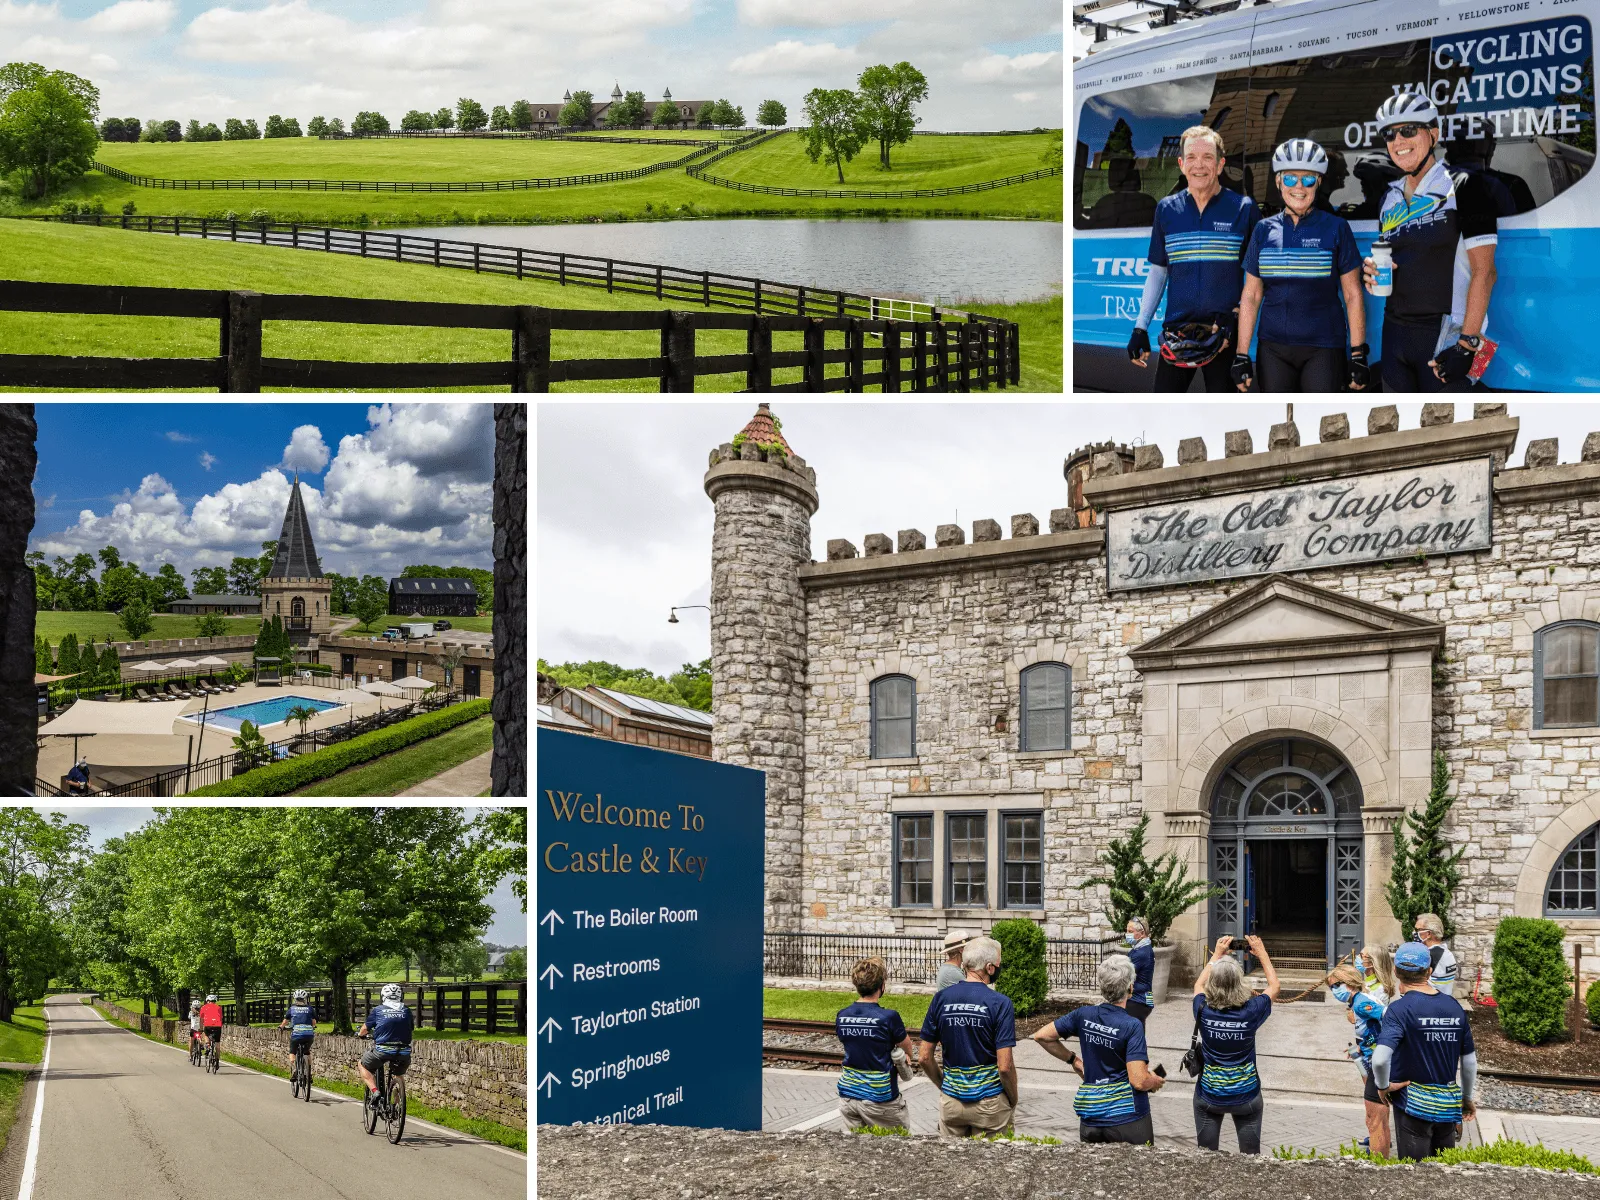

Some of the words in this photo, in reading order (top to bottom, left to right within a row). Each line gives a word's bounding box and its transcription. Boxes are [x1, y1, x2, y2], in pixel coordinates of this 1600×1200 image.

[1111, 75, 1122, 83] NEW
[1123, 71, 1143, 80] MEXICO
[1176, 62, 1191, 71] PALM
[1192, 57, 1218, 68] SPRINGS
[1229, 52, 1250, 60] SANTA
[1252, 45, 1284, 57] BARBARA
[1297, 36, 1331, 49] SOLVANG
[1346, 28, 1379, 40] TUCSON
[1396, 18, 1439, 31] VERMONT
[1458, 2, 1530, 21] YELLOWSTONE
[1434, 24, 1583, 70] CYCLING
[1344, 120, 1378, 148] OF
[1437, 104, 1581, 142] IFETIME
[1092, 257, 1152, 276] TRE
[1133, 509, 1208, 546] The
[1222, 496, 1298, 534] Old
[1309, 476, 1456, 527] Taylor
[1119, 540, 1285, 581] Distillery
[1303, 515, 1478, 559] Company
[544, 789, 671, 830] Welcome
[678, 804, 705, 832] To
[1294, 824, 1308, 834] Key
[544, 841, 633, 873] Castle
[640, 847, 660, 874] &
[667, 847, 709, 882] Key
[572, 910, 606, 929] The
[610, 908, 656, 927] Boiler
[659, 907, 698, 924] Room
[573, 958, 661, 983] Restrooms
[571, 1007, 647, 1036] Taylorton
[651, 996, 700, 1018] Station
[943, 1003, 988, 1014] TREK
[838, 1016, 880, 1026] TREK
[945, 1016, 984, 1029] TRAVEL
[1083, 1019, 1120, 1036] TREK
[1204, 1018, 1249, 1029] TREK
[1417, 1017, 1461, 1026] TREK
[841, 1027, 876, 1038] TRAVEL
[1084, 1032, 1115, 1050] TRAVEL
[1208, 1029, 1246, 1041] TRAVEL
[1423, 1032, 1458, 1042] TRAVEL
[571, 1049, 671, 1090] Springhouse
[653, 1086, 684, 1110] Trail
